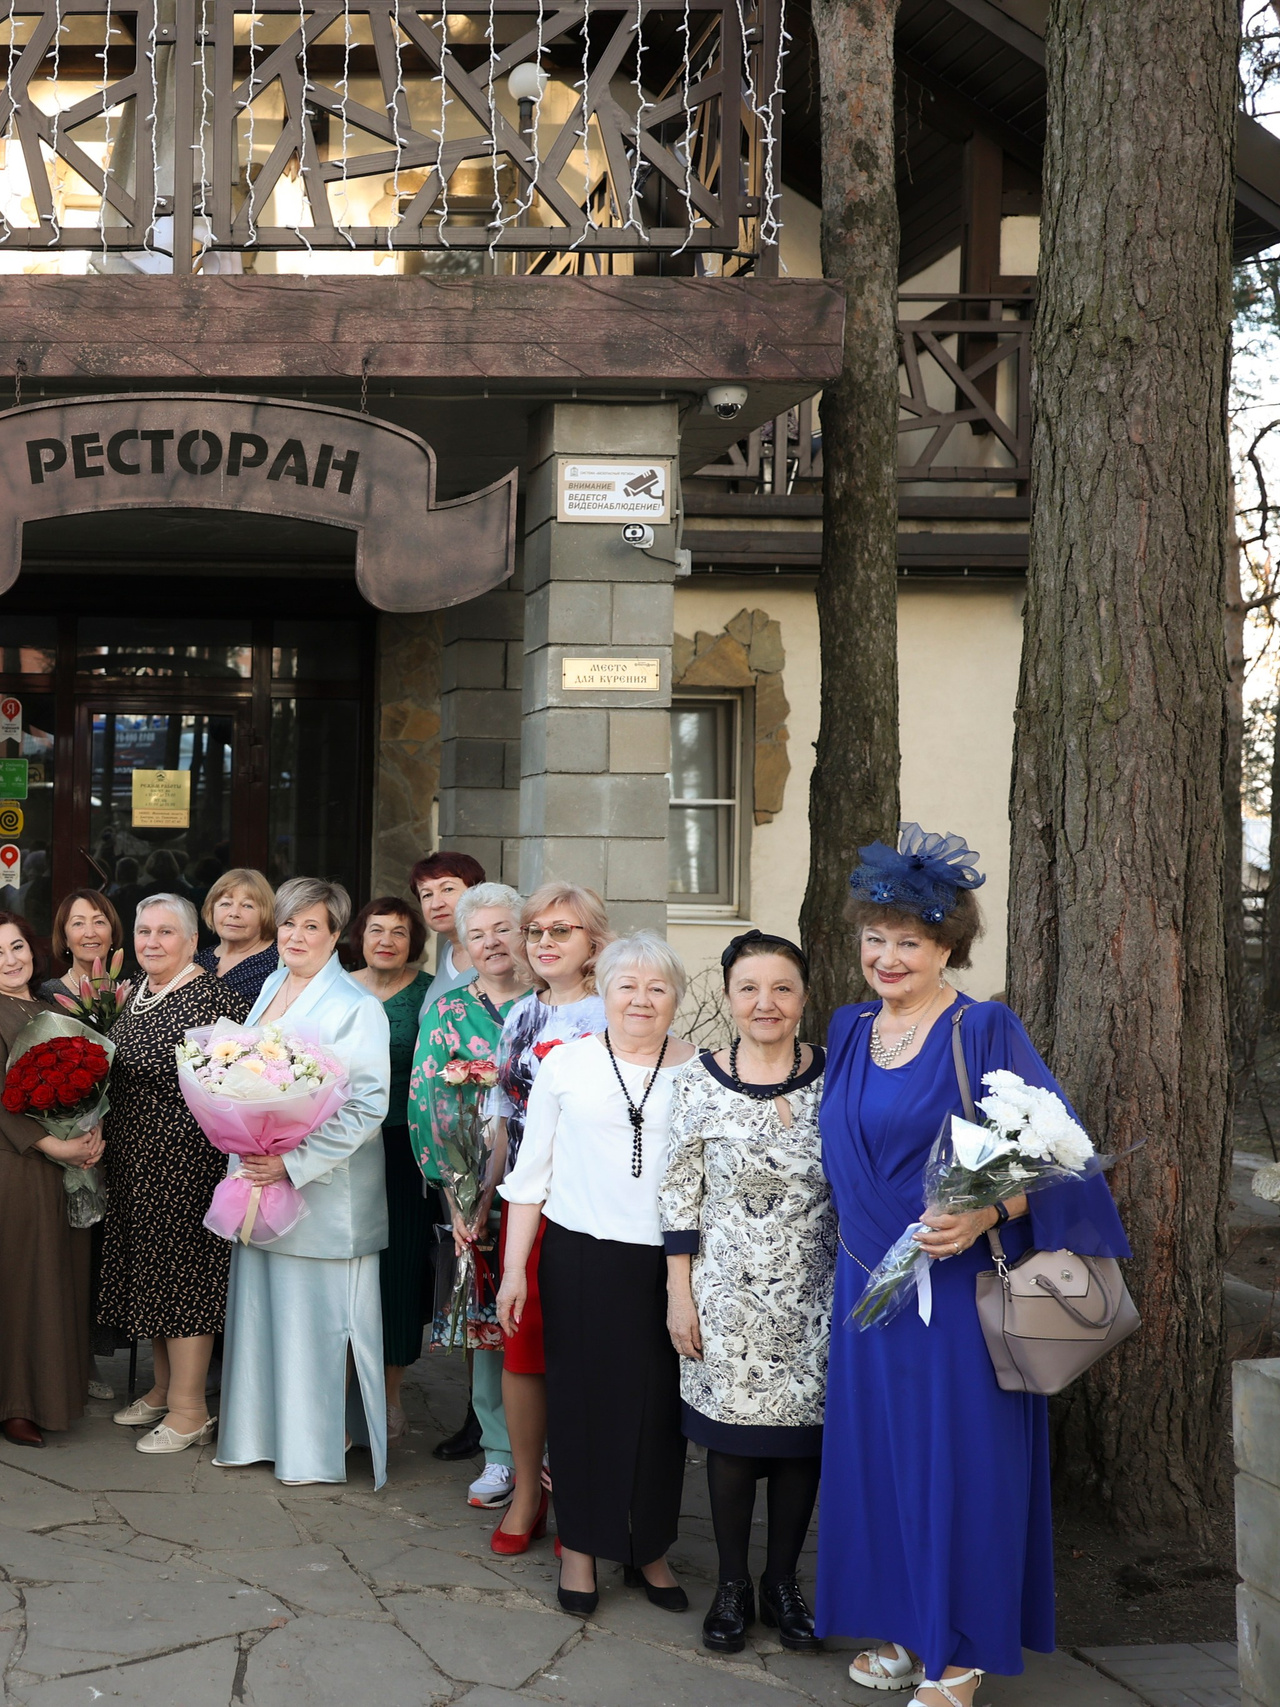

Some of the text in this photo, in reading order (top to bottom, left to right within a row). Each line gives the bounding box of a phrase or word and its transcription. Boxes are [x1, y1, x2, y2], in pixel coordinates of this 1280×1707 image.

[25, 428, 360, 496] РЕСТОРАН
[568, 482, 612, 490] ВНИМАНИЕ
[568, 493, 607, 502] ВЕДЕТСЯ
[568, 502, 660, 511] ВИДЕОНАБЛЮДЕНИЕ!
[590, 664, 628, 672] МЕСТО
[574, 675, 647, 685] ДЛЯ КУРЕНИЯ
